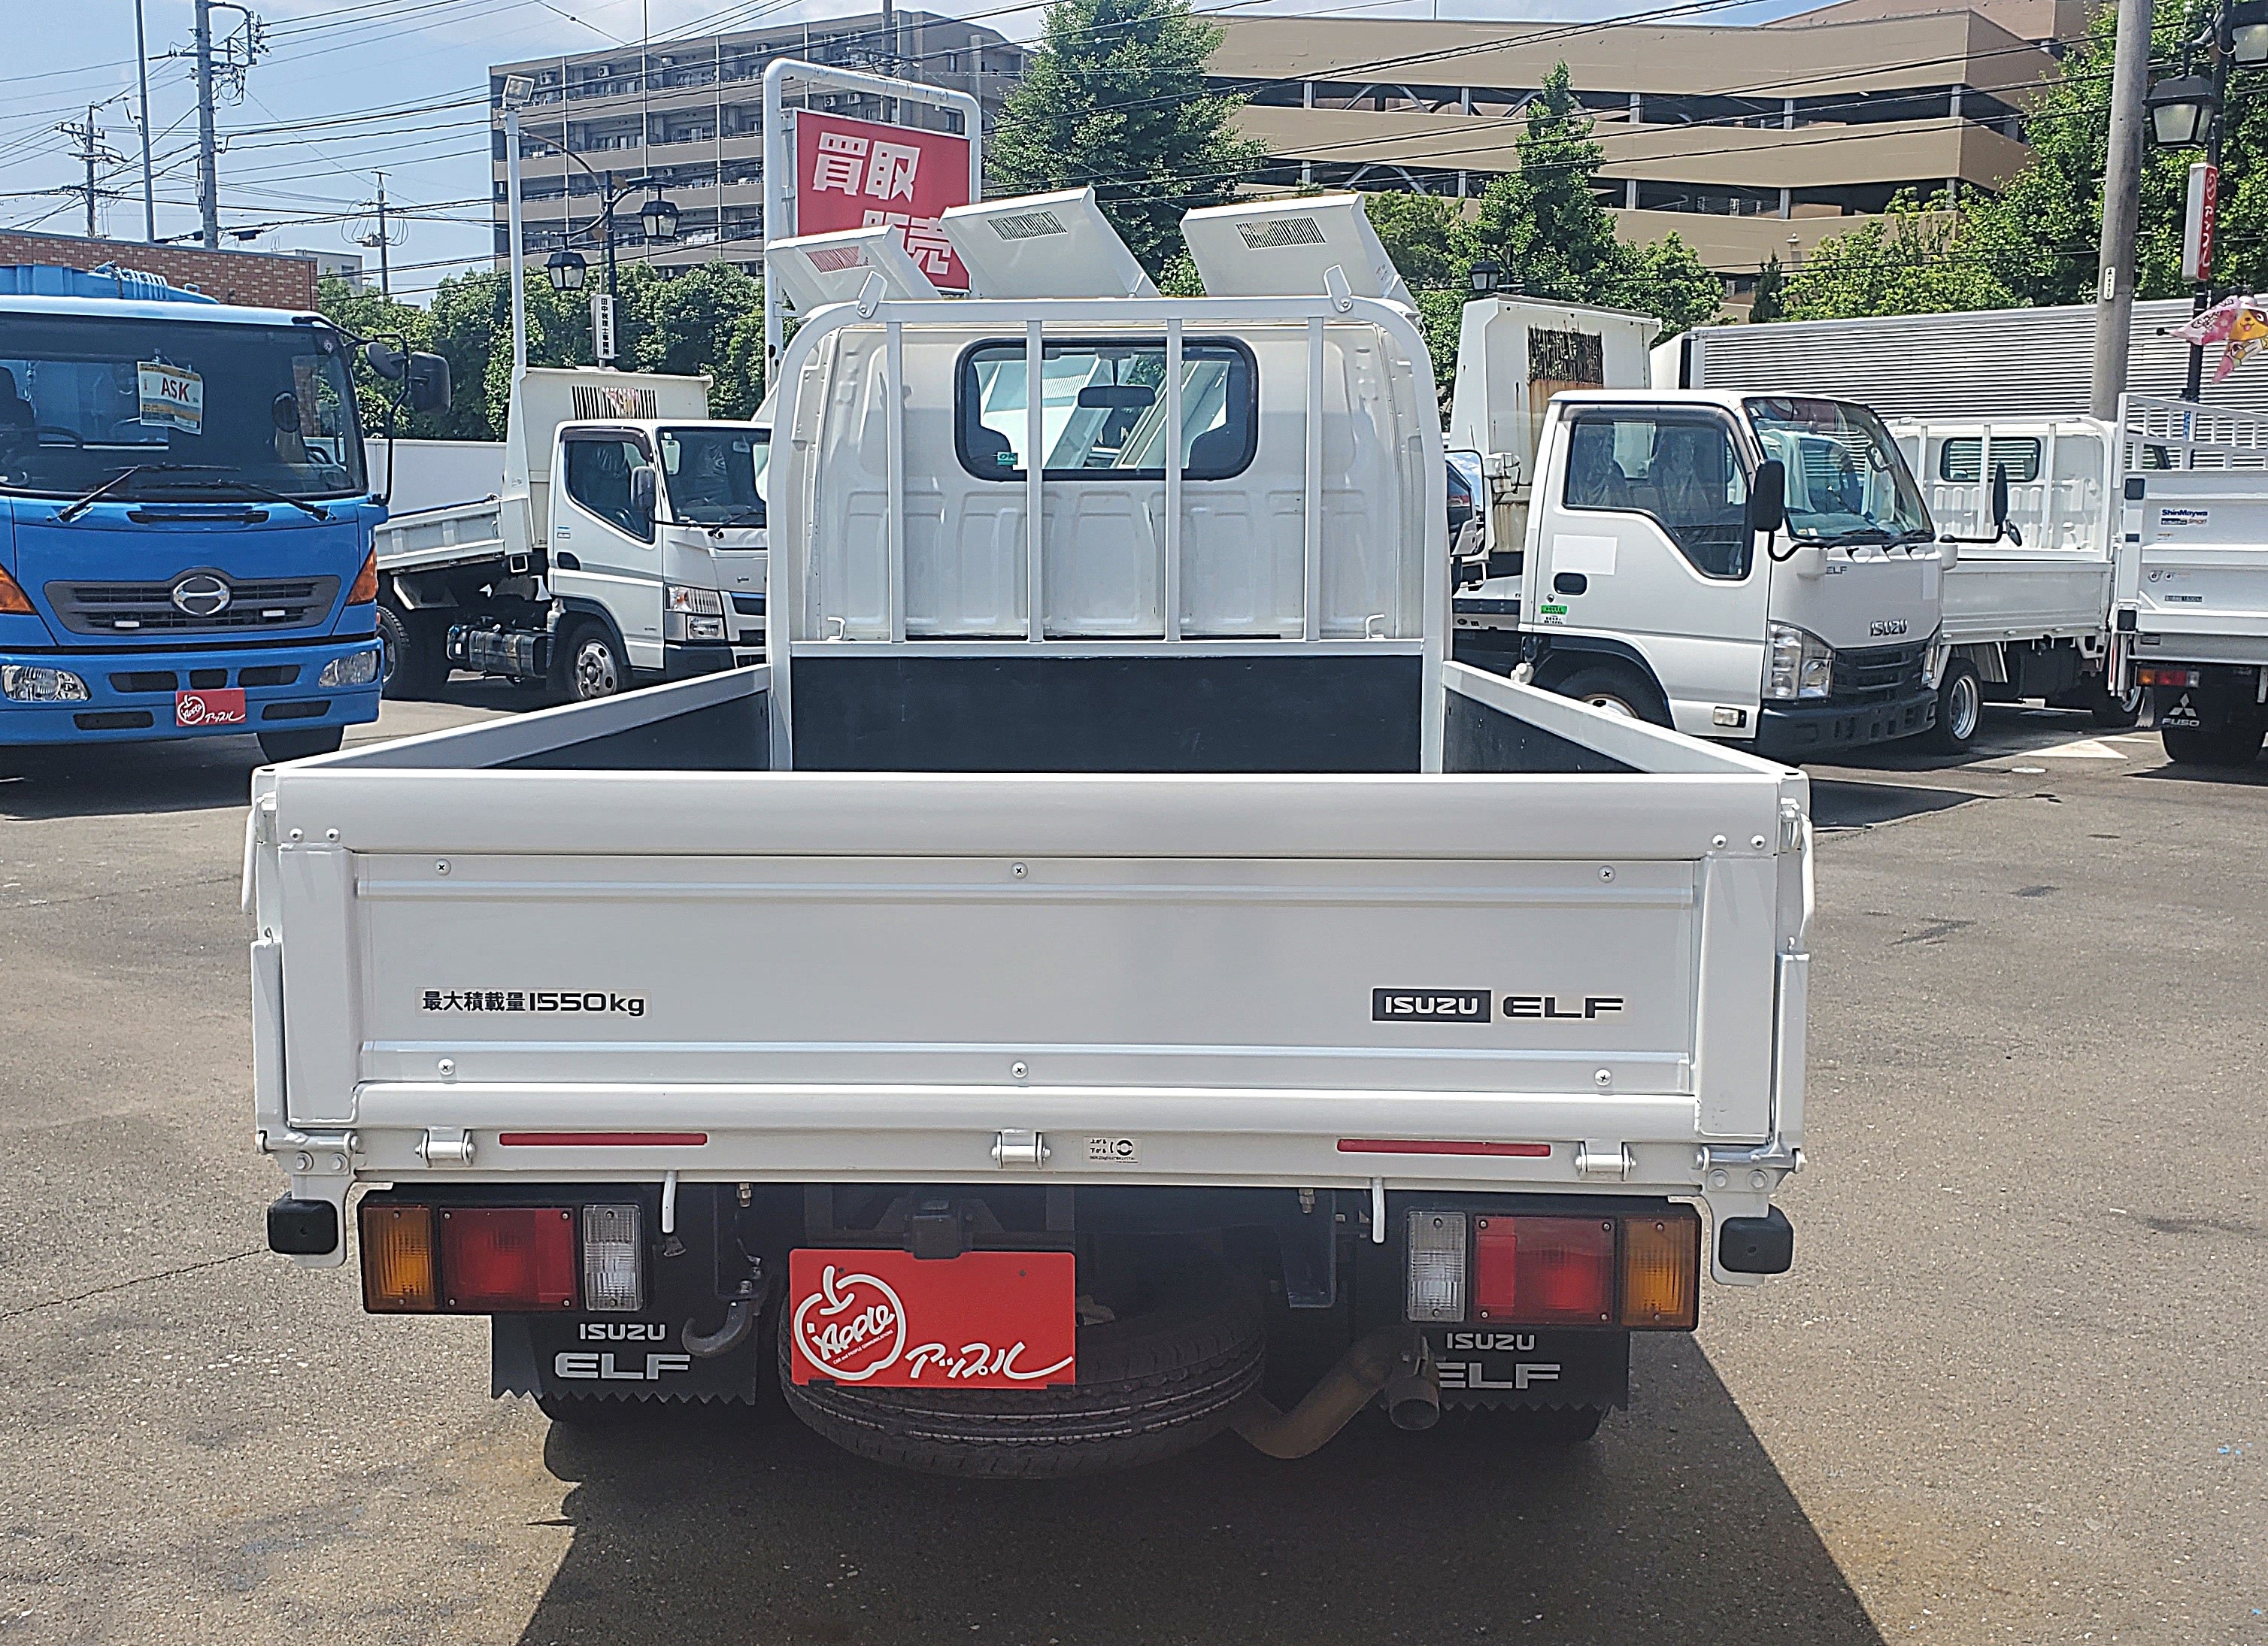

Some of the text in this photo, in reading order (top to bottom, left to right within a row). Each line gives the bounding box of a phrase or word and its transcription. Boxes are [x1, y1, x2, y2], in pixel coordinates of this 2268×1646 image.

[812, 131, 921, 203] 買取
[863, 209, 952, 275] 売
[161, 377, 190, 402] ASK
[2161, 509, 2209, 517] ShinMaywa
[1826, 566, 1848, 574] ELF
[1869, 619, 1908, 637] ISUZU
[2162, 717, 2200, 726] FUSO
[423, 991, 645, 1017] 最大積載量1550kg
[1385, 996, 1624, 1019] ISUZU ELF
[580, 1323, 666, 1340] ISUZU
[1447, 1332, 1535, 1350] ISUZU
[555, 1353, 690, 1380] ELF
[905, 1341, 1074, 1380] アップル
[1436, 1362, 1560, 1389] ELF
